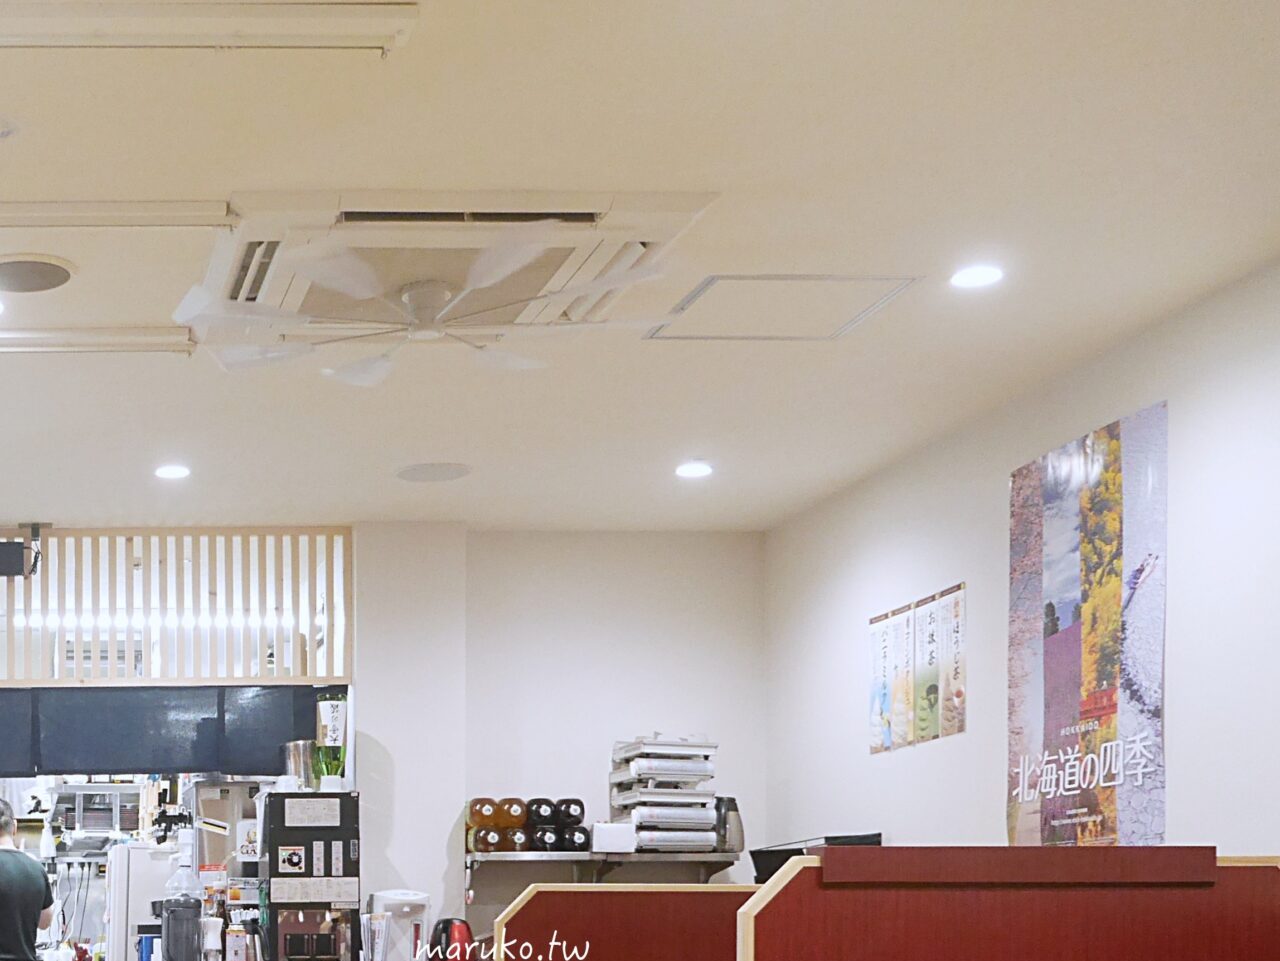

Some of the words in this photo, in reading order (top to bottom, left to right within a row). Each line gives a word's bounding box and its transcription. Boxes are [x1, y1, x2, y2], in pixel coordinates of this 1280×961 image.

[1012, 731, 1156, 803] 北海道の四季
